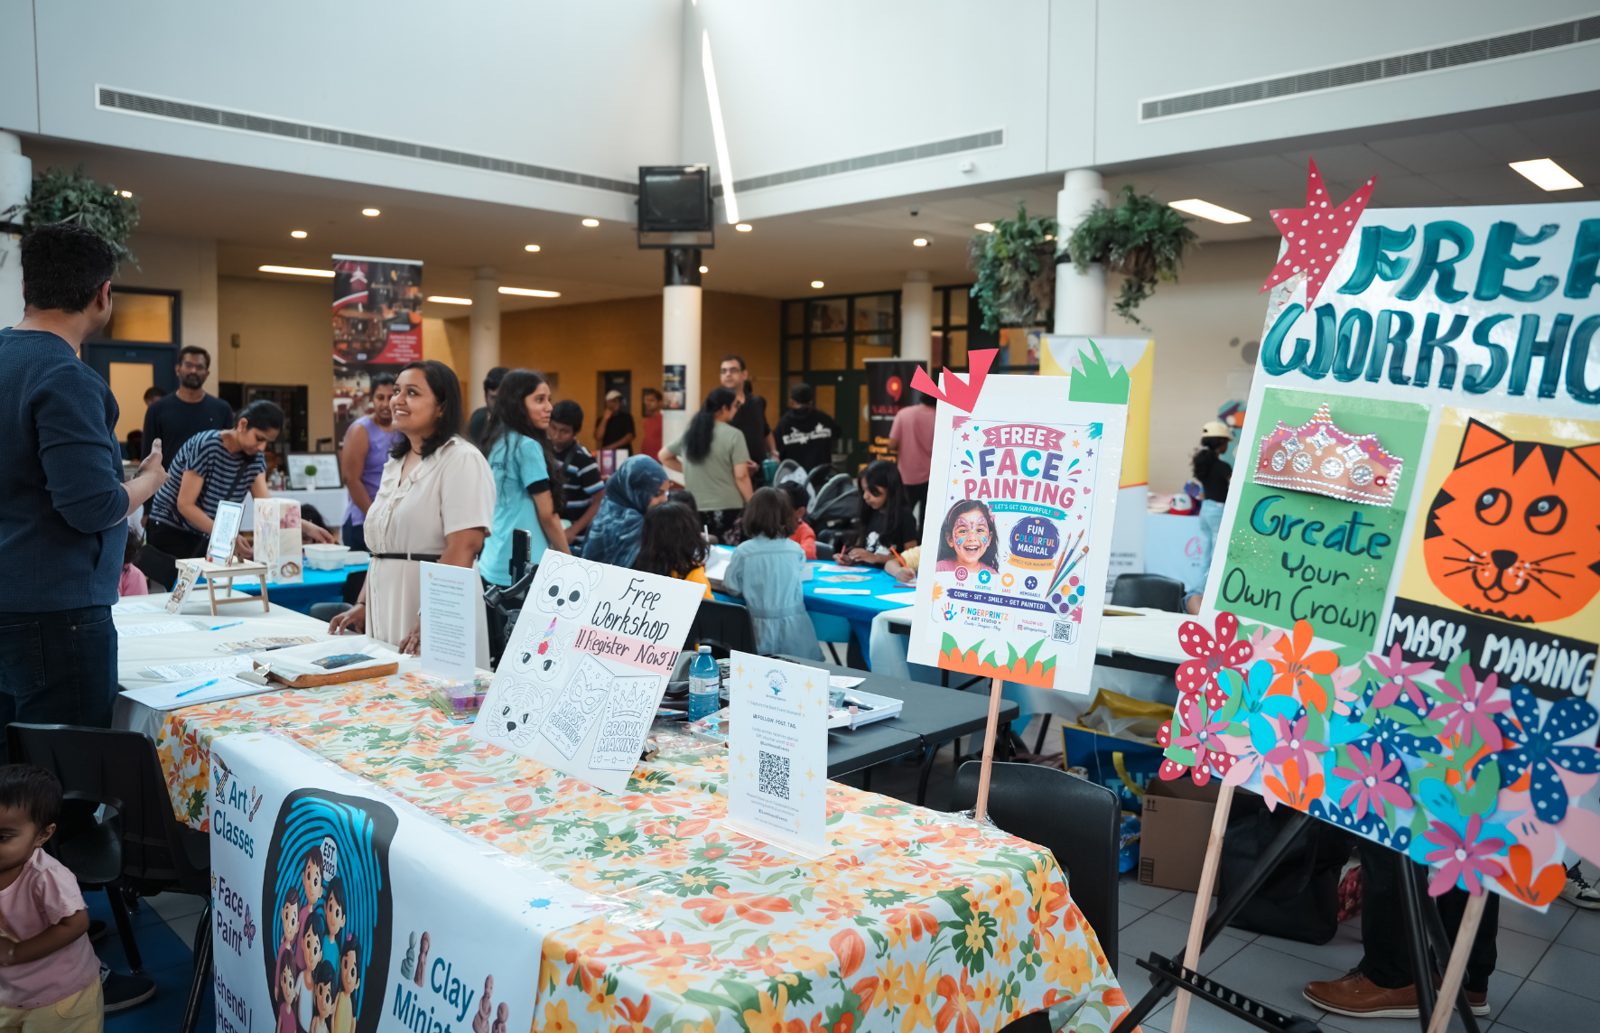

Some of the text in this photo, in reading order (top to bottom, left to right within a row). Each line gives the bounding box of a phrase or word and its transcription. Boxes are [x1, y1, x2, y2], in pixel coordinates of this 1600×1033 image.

[1000, 427, 1047, 447] FREE
[979, 448, 1064, 481] FACE
[964, 478, 1076, 509] PAINTING
[1019, 505, 1051, 515] COLOURFUL!
[1014, 533, 1056, 547] COLOURFUL
[1027, 524, 1045, 536] FUN
[1016, 543, 1049, 556] MAGICAL
[619, 577, 661, 610] Free
[953, 591, 1046, 611] COME SIT SMILE GET PAINTED!
[1222, 567, 1377, 637] Own Crown
[591, 600, 670, 644] Workshop
[1386, 612, 1467, 662] MASK
[550, 711, 581, 747] COLOURING
[559, 703, 587, 731] MASK
[602, 720, 643, 738] CROWN
[598, 737, 640, 754] MAKING
[228, 781, 248, 814] Art
[213, 809, 254, 859] Classes
[323, 841, 336, 861] EST
[322, 859, 335, 876] 2023
[218, 875, 244, 918] Face
[216, 910, 243, 957] Paint
[431, 956, 475, 1023] Clay
